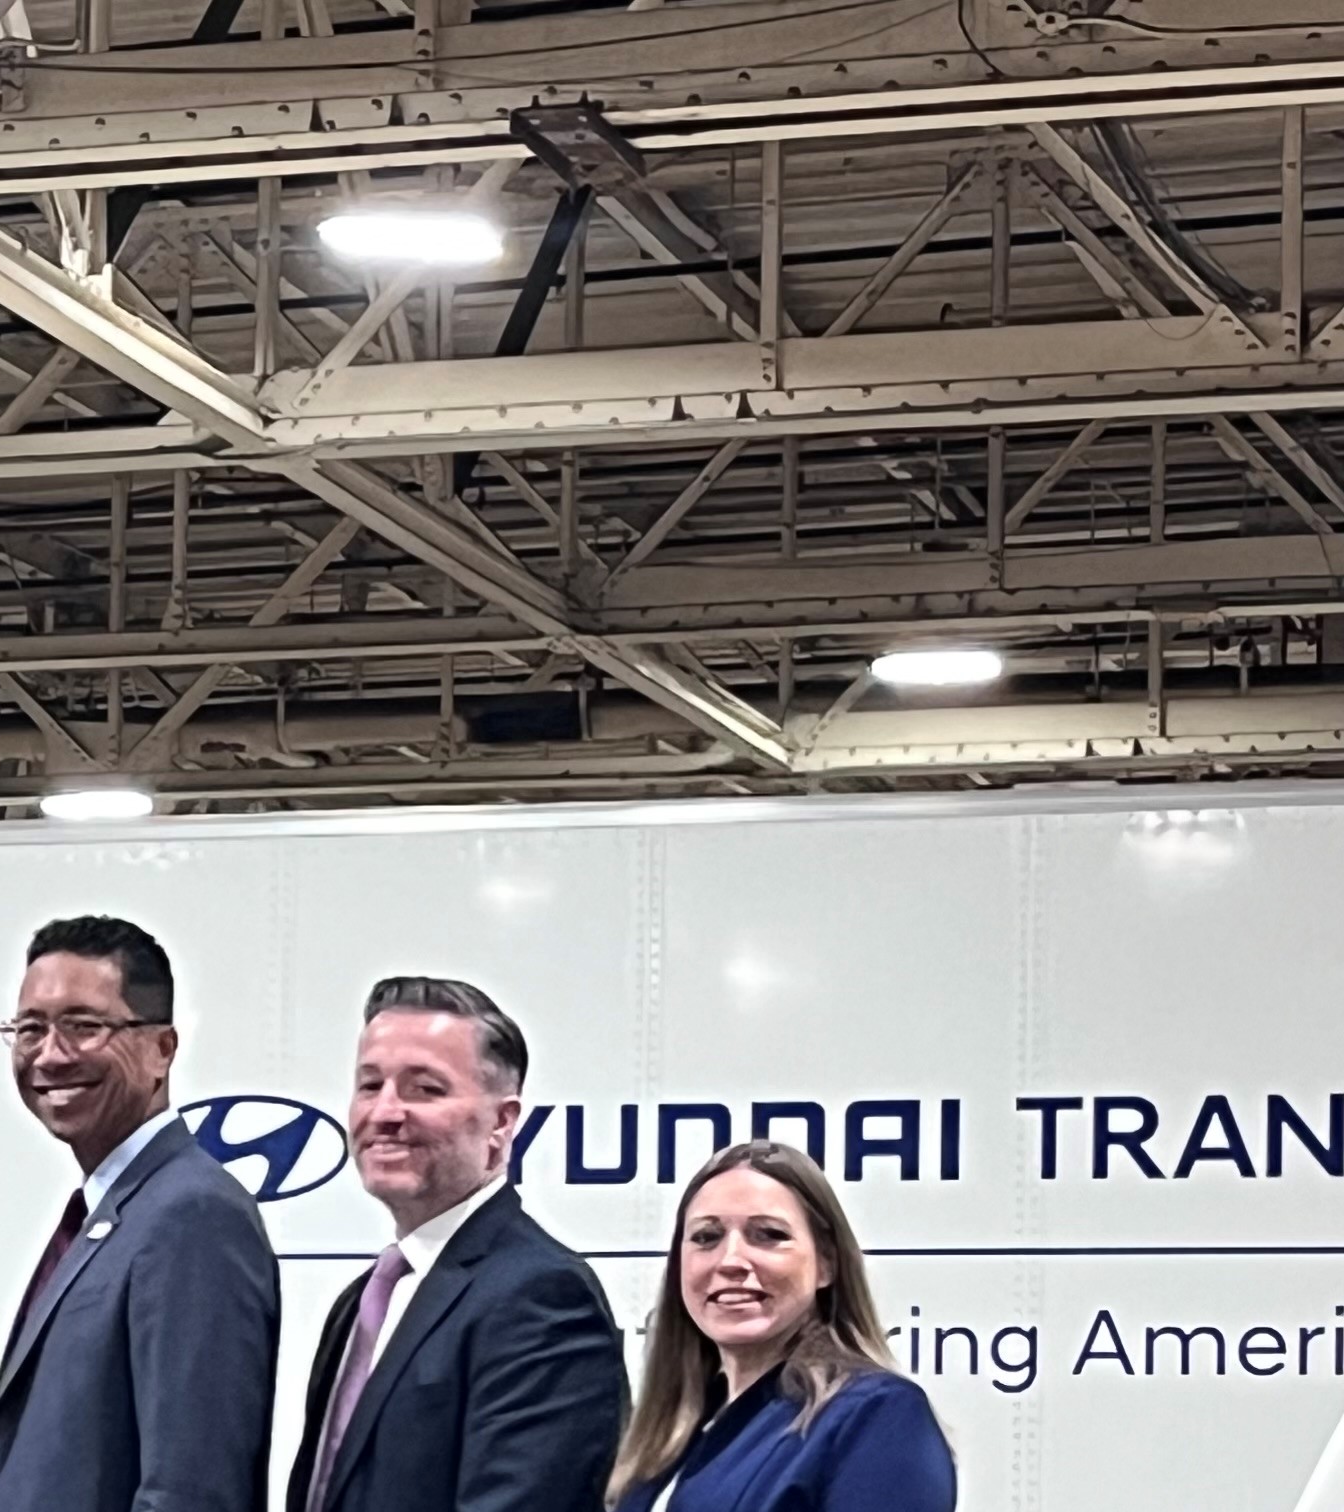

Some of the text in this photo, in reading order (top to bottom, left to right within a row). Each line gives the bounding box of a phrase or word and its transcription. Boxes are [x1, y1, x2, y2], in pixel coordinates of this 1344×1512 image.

[507, 1099, 960, 1185] YUNDAI
[1016, 1093, 1344, 1179] TRAN
[1072, 1306, 1344, 1376] Ameri
